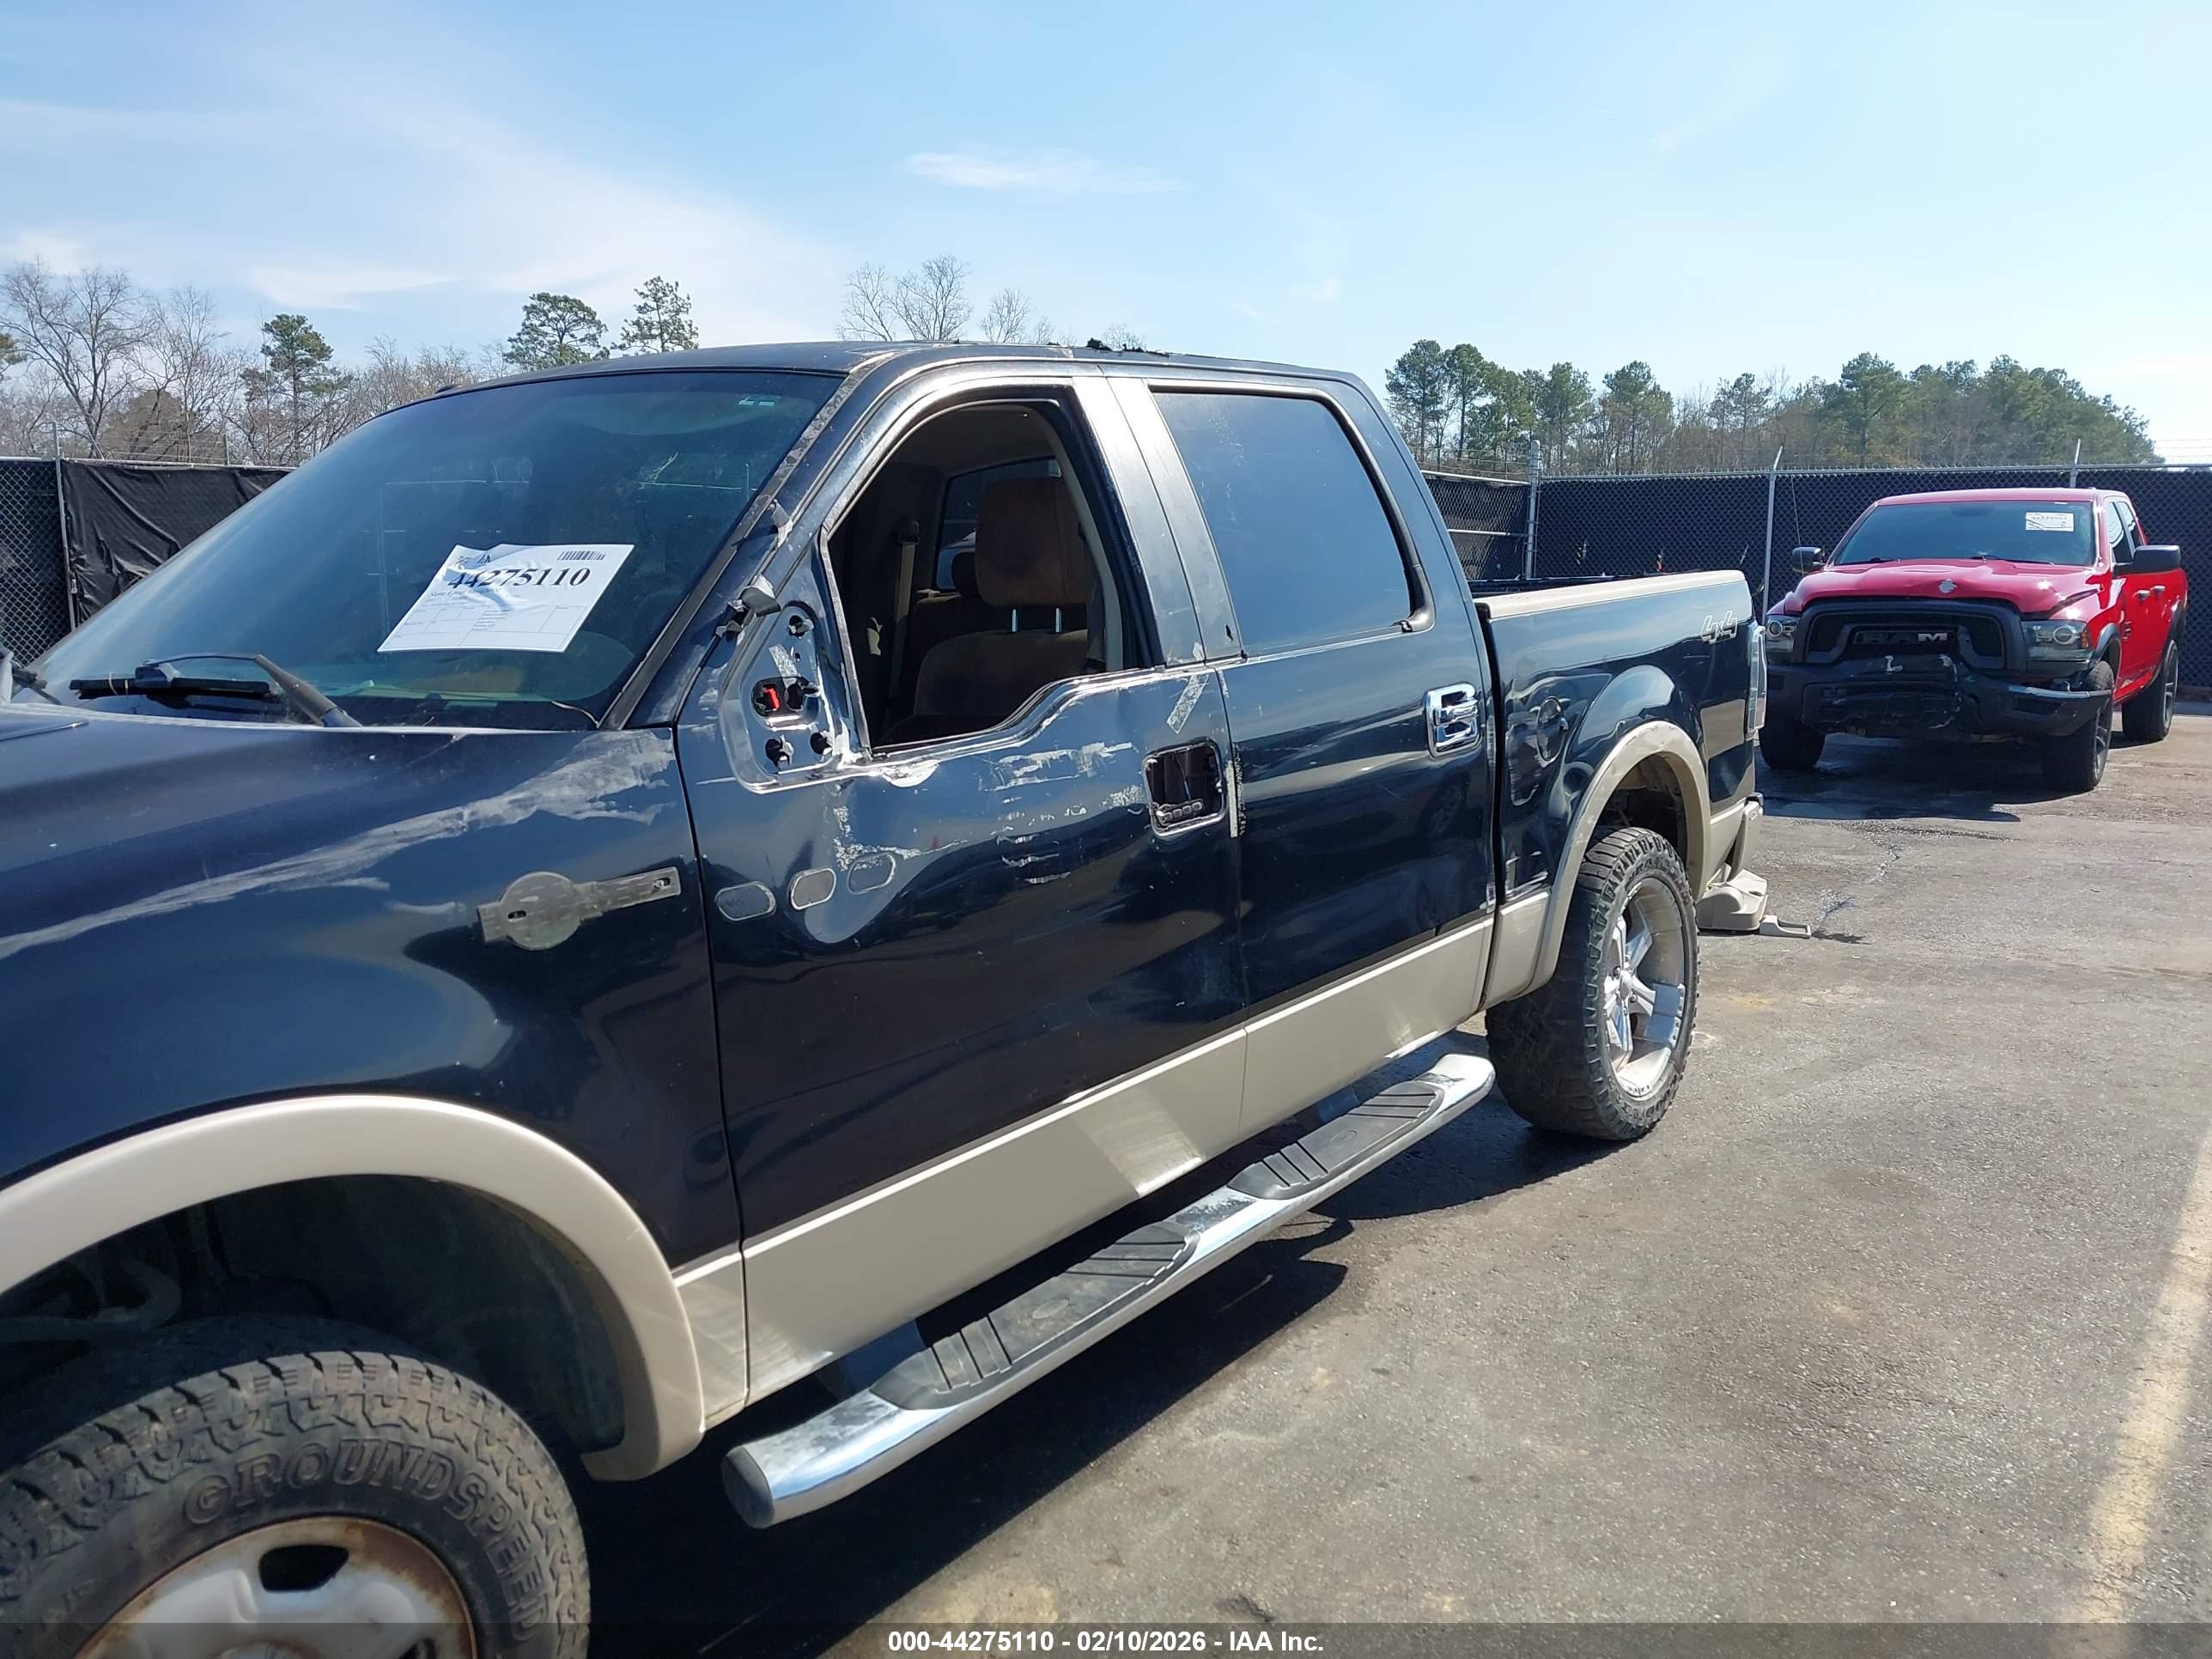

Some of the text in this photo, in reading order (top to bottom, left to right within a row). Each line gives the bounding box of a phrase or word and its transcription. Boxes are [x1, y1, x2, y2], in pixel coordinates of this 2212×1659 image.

[447, 567, 592, 588] 44275110
[1700, 610, 1738, 645] 4x4
[182, 1437, 550, 1642] GROUNDSPEED
